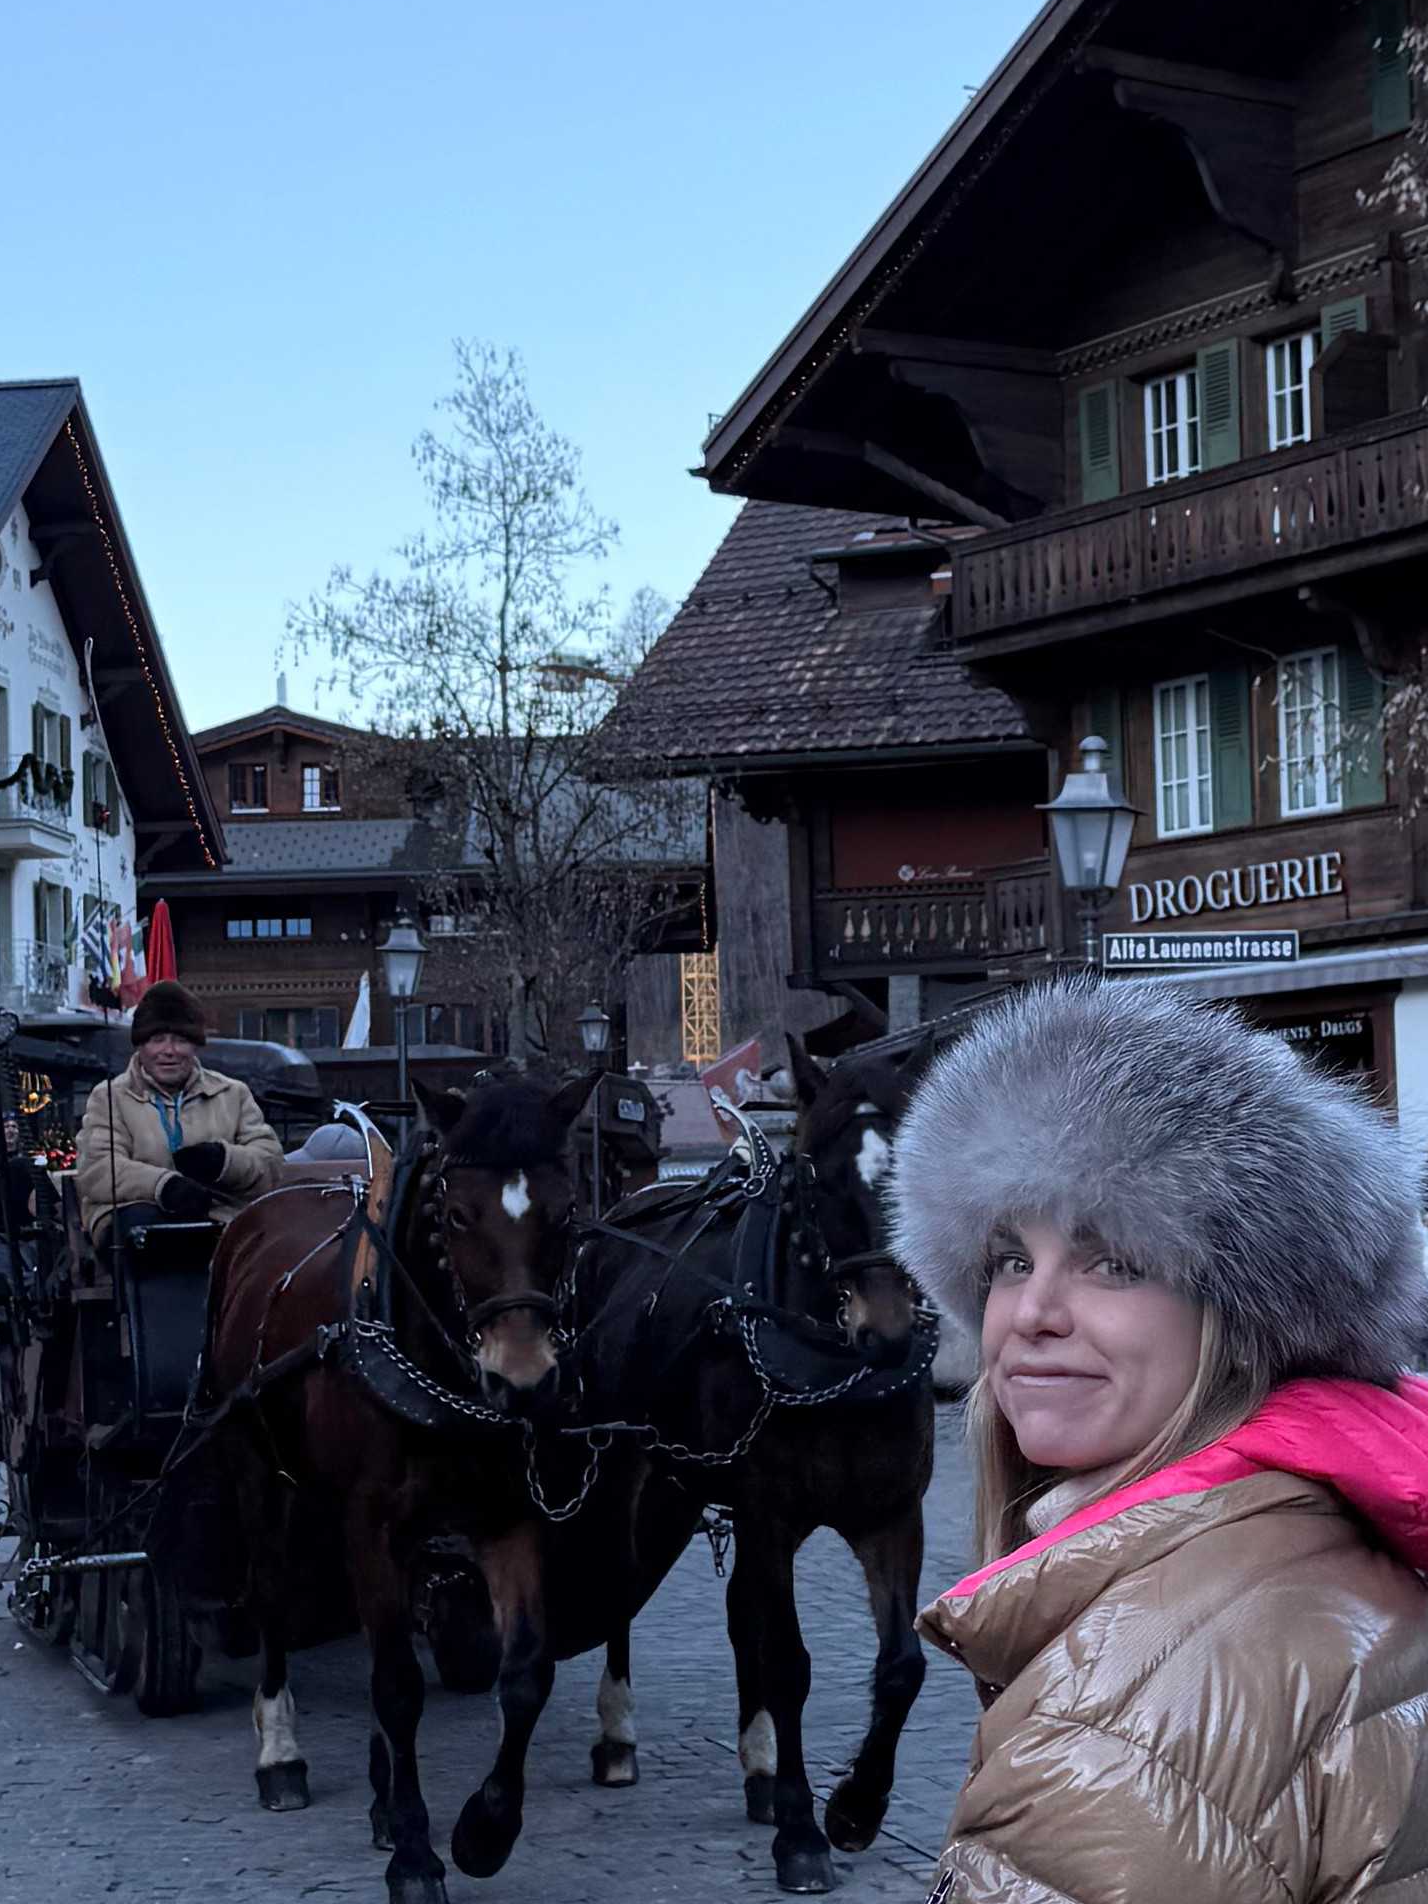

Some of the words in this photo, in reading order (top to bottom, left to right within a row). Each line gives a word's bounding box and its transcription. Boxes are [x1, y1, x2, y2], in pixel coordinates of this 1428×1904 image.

[1128, 851, 1343, 923] DROGUERIE
[1109, 938, 1146, 960] Alte
[1150, 936, 1292, 960] Lauenenstrasse
